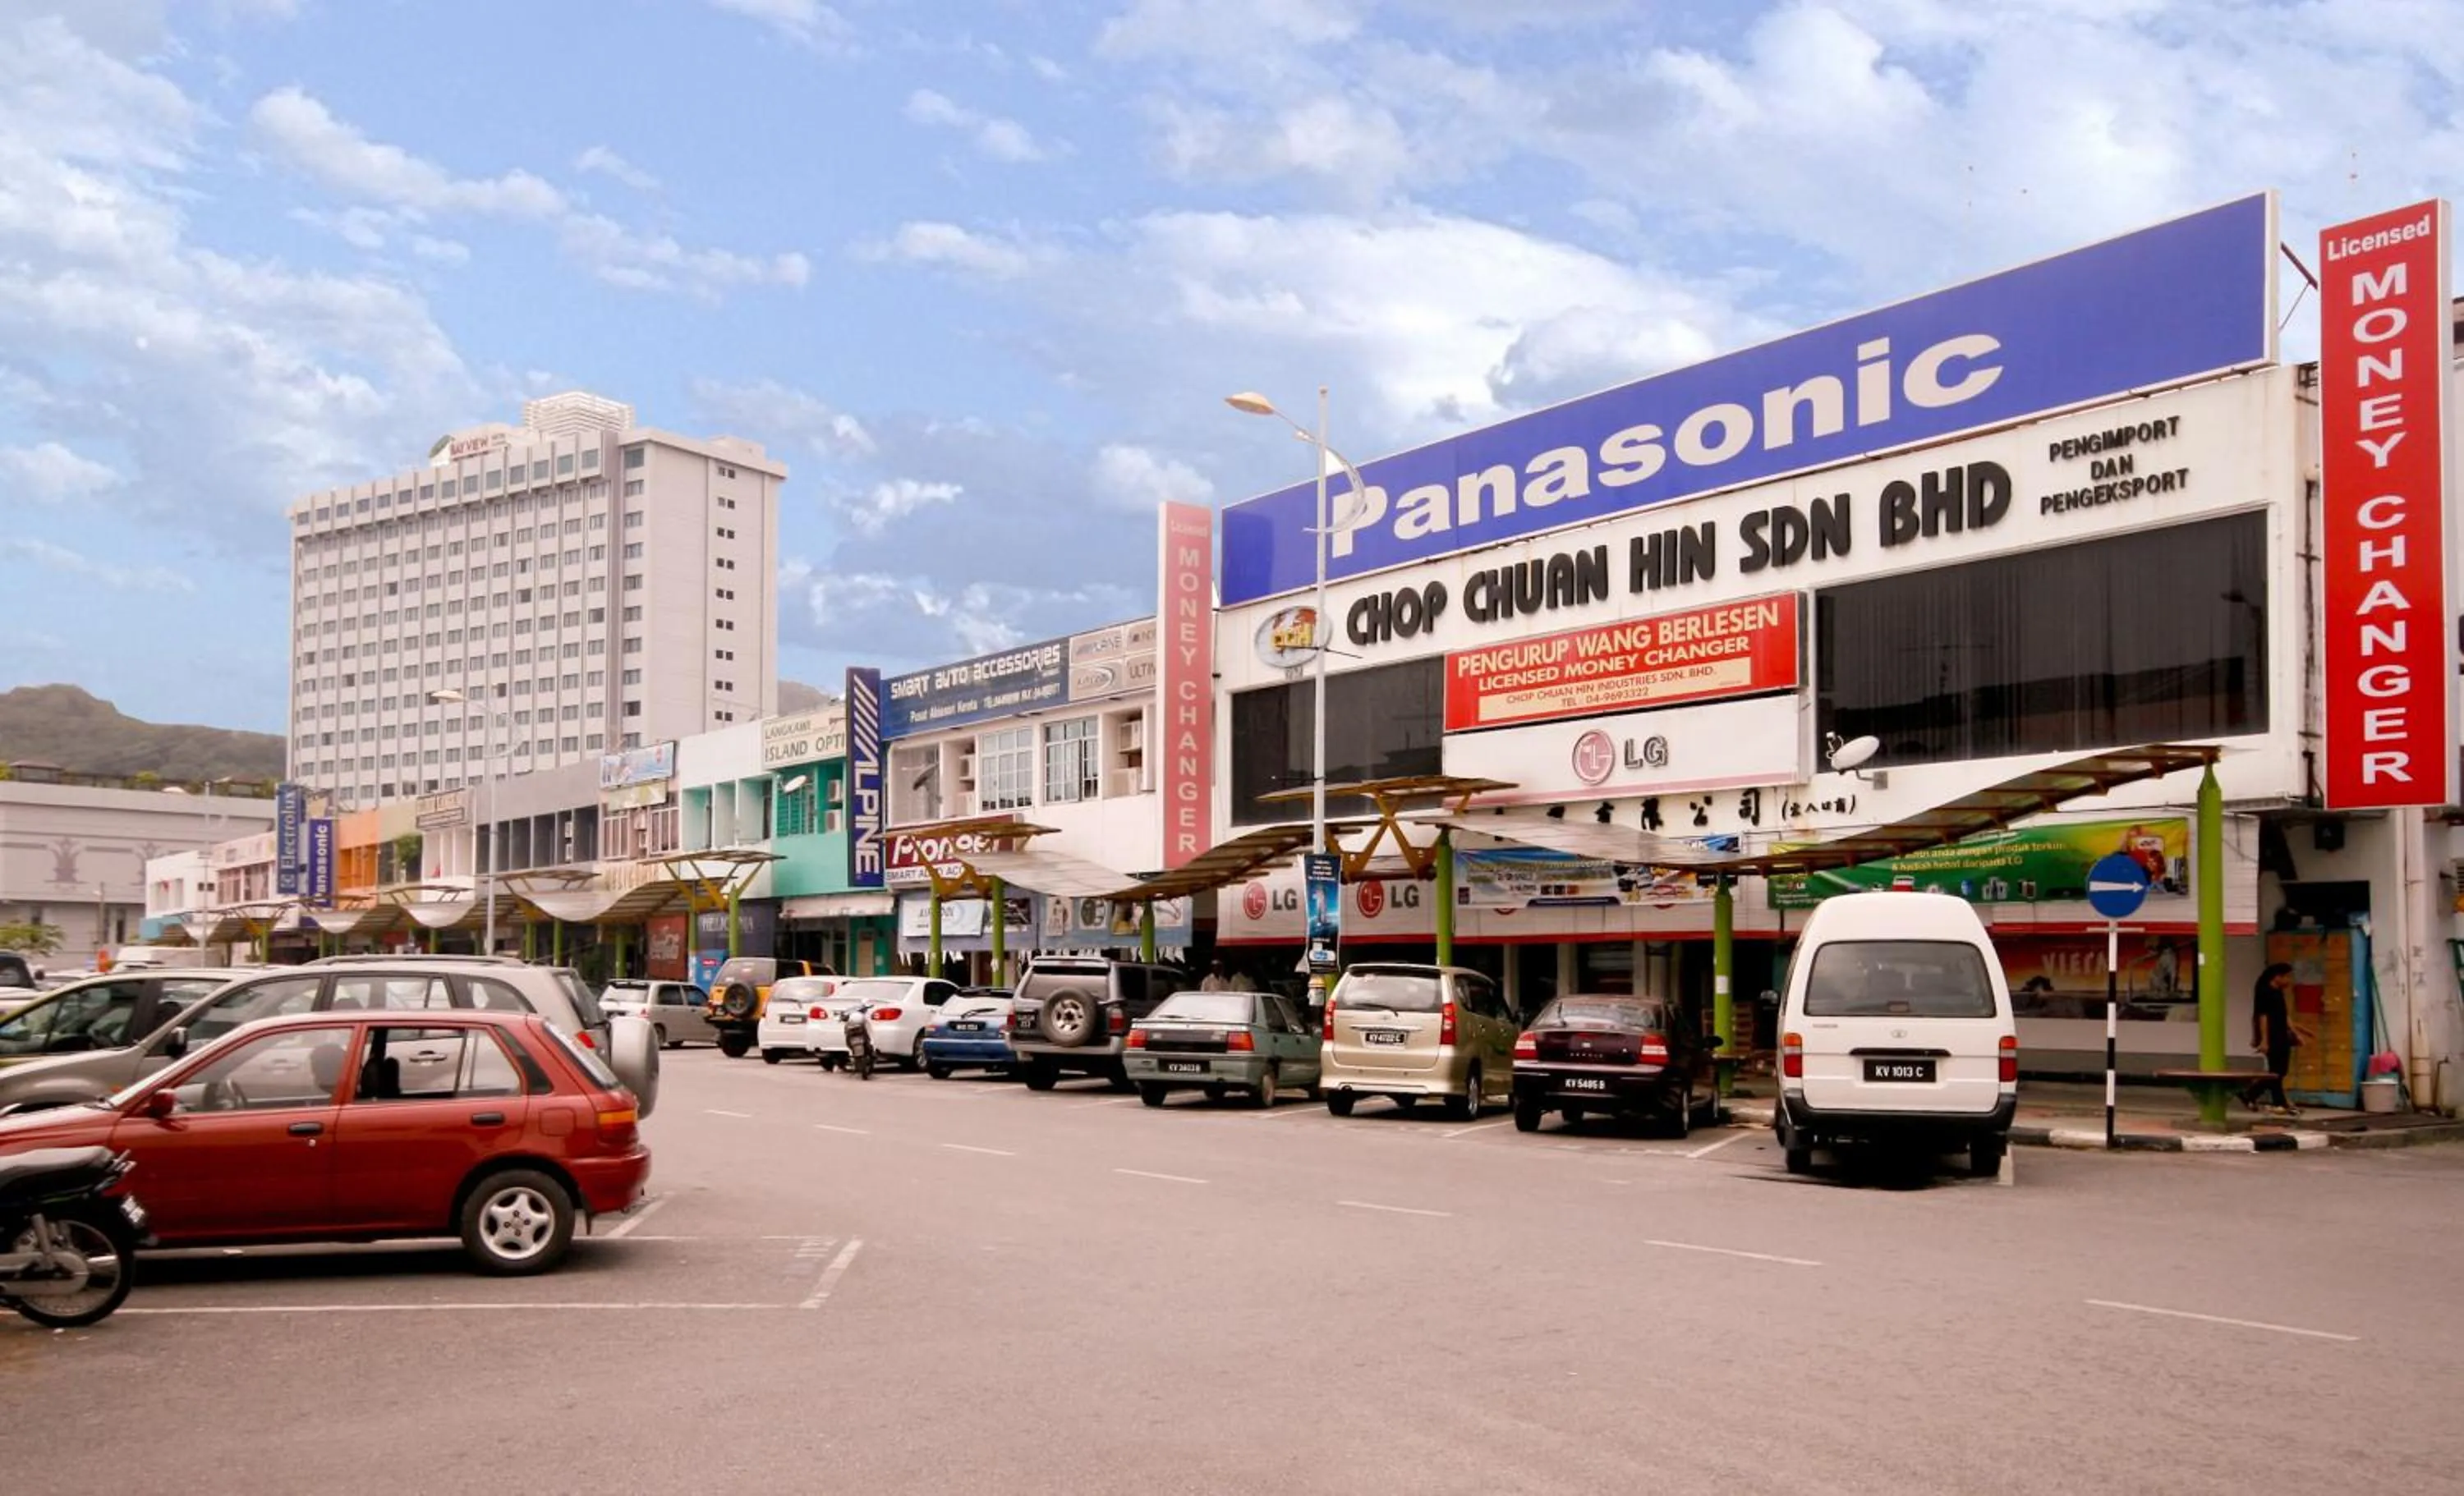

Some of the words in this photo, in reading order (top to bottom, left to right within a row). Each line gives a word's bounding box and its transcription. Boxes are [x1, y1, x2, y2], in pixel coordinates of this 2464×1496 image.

[2328, 214, 2431, 261] Licensed
[2351, 262, 2408, 468] MONEY
[1329, 333, 2004, 560] Panasonic
[2048, 415, 2181, 462] PENGIMPORT
[2039, 468, 2190, 516] PENGEKSPORT
[2090, 454, 2134, 481] DAN
[1346, 580, 1447, 646] CHOP
[1463, 544, 1608, 622] CHUAN
[1629, 521, 1716, 594] HIN
[1739, 493, 1851, 574] SDN
[1878, 460, 2012, 548] BHD
[1177, 546, 1201, 667] MONEY
[1458, 642, 1570, 678] PENGURUP
[1576, 624, 1651, 657] WANG
[1657, 603, 1778, 645] BERLESEN
[1478, 668, 1559, 691] LICENSED
[1564, 653, 1639, 678] MONEY
[1643, 636, 1750, 666] CHANGER
[2356, 494, 2413, 785] CHANGER
[1506, 693, 1534, 704] CHOP
[1536, 687, 1574, 701] CHUAN
[1575, 683, 1595, 695] HIN
[1597, 674, 1658, 691] INDUSTRIES
[765, 740, 808, 763] ISLAND
[1177, 681, 1199, 854] CHANGER
[1624, 736, 1669, 769] LG
[854, 710, 880, 875] ALPINE
[280, 792, 296, 870] Electrolux
[1272, 888, 1298, 911] LG
[1391, 883, 1419, 909] LG
[1875, 1066, 1890, 1077] KV
[1892, 1066, 1914, 1077] 1013
[1915, 1066, 1924, 1078] C
